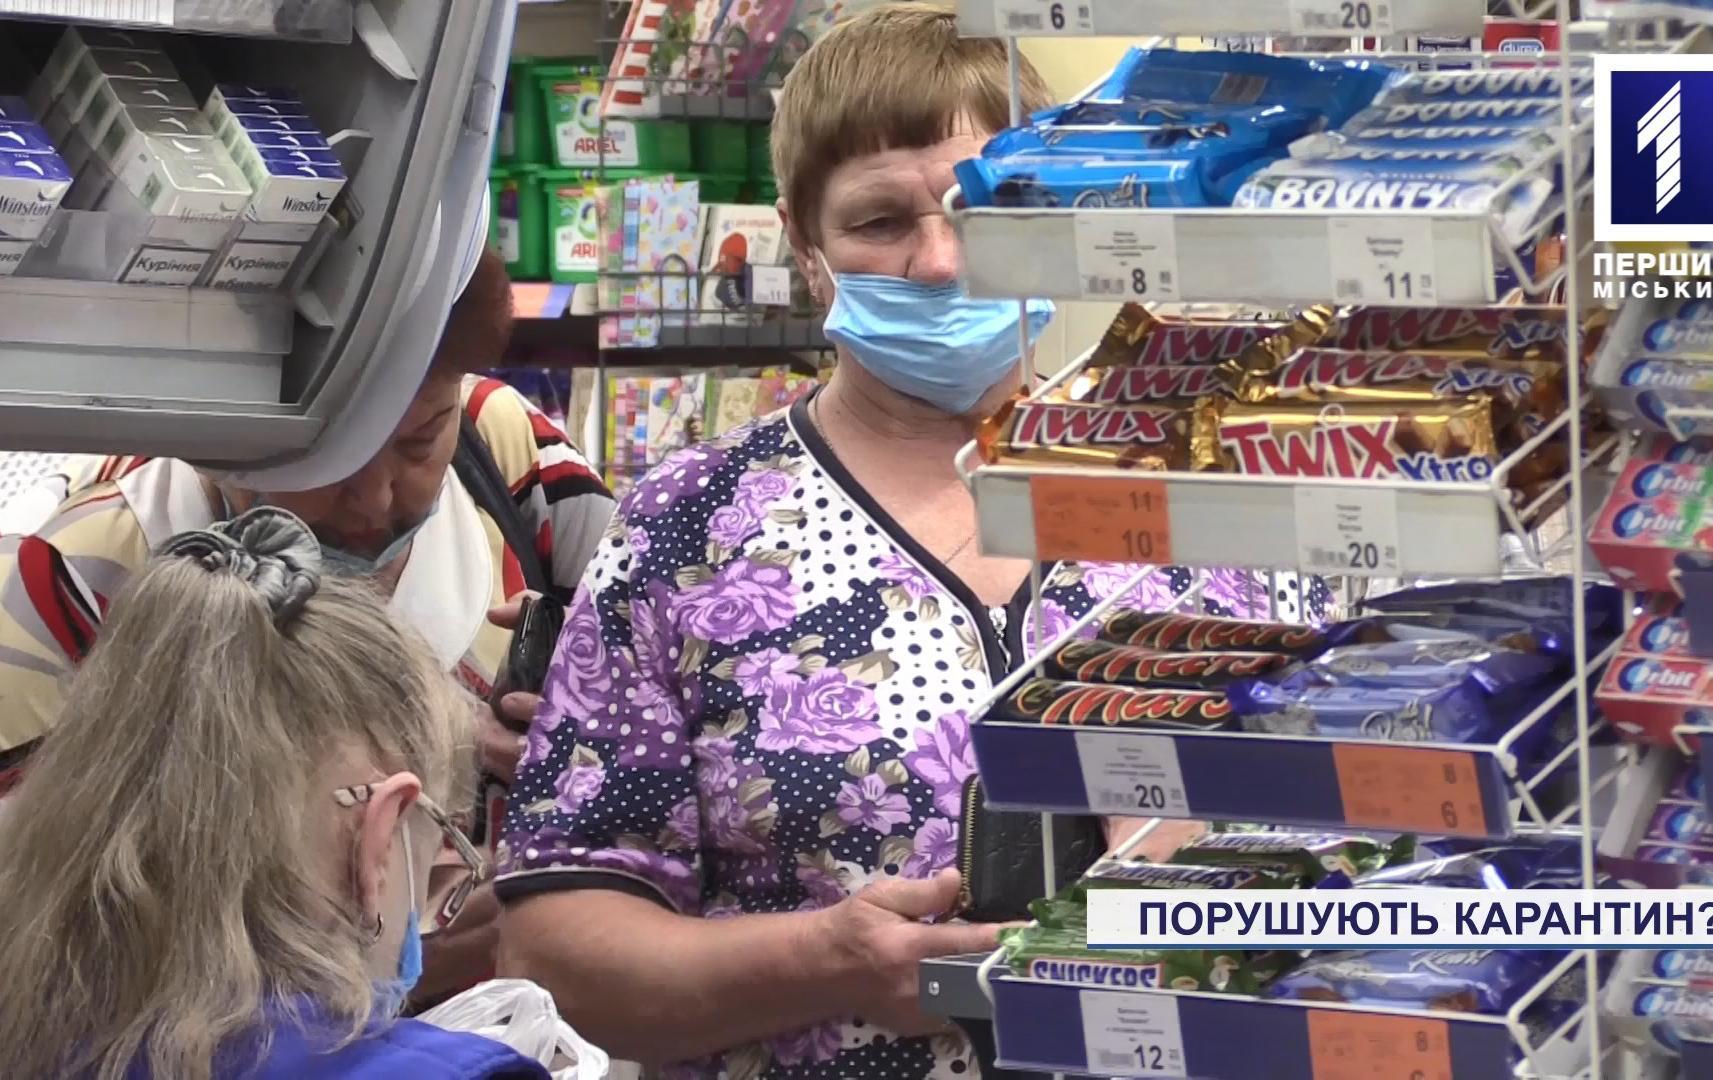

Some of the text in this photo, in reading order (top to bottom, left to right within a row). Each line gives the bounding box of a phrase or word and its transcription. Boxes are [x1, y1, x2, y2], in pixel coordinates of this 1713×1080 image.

[1050, 2, 1065, 31] 6
[1340, 2, 1372, 30] 20
[573, 137, 622, 155] ARIEL
[281, 195, 328, 213] Winston
[1272, 177, 1459, 209] BOUNTY
[1131, 266, 1147, 295] 8
[1383, 271, 1412, 299] 11
[1010, 403, 1175, 449] TWIX
[1220, 418, 1402, 478] TWIX
[1128, 490, 1152, 513] 11
[1612, 504, 1686, 538] Orbit
[1121, 528, 1153, 559] 10
[1347, 541, 1379, 570] 20
[1618, 658, 1699, 693] Orbit
[1134, 783, 1166, 810] 20
[1441, 800, 1458, 829] 6
[1134, 1043, 1165, 1070] 12
